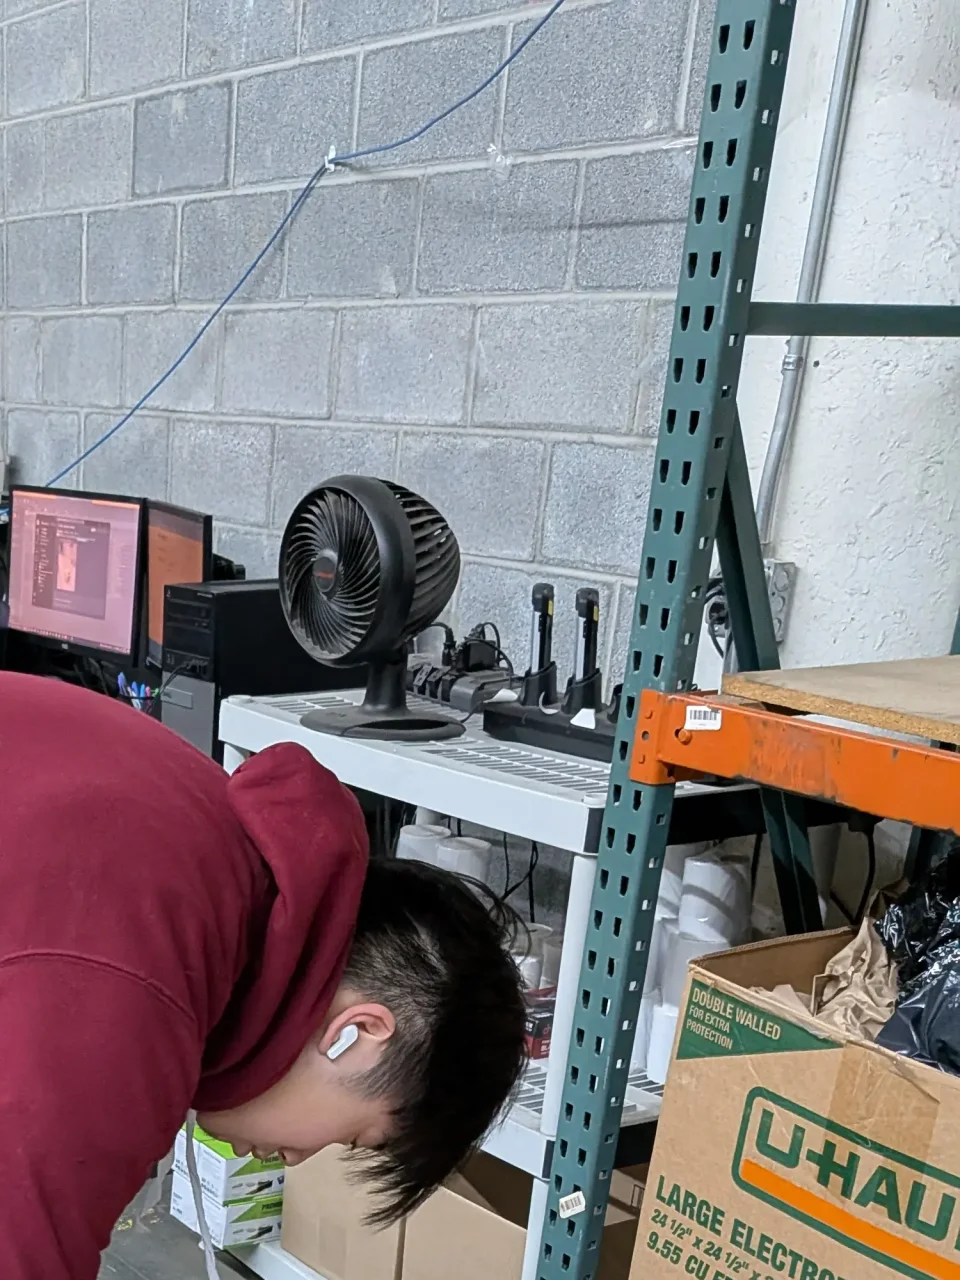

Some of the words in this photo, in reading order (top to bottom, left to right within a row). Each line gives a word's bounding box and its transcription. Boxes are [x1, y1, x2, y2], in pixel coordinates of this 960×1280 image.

[686, 1020, 733, 1050] PROTECTION
[689, 1005, 704, 1022] FOR
[704, 1011, 730, 1034] EXTRA
[692, 987, 733, 1018] DOUBLE
[735, 1005, 781, 1040] WALLED
[655, 1175, 725, 1237] LARGE
[755, 1108, 960, 1252] U-HAU
[646, 1231, 683, 1265] 9.55
[685, 1254, 711, 1280] CU
[651, 1208, 668, 1228] 24
[670, 1219, 692, 1240] 1/2"
[704, 1242, 722, 1262] 24
[725, 1252, 749, 1273] 1/2"
